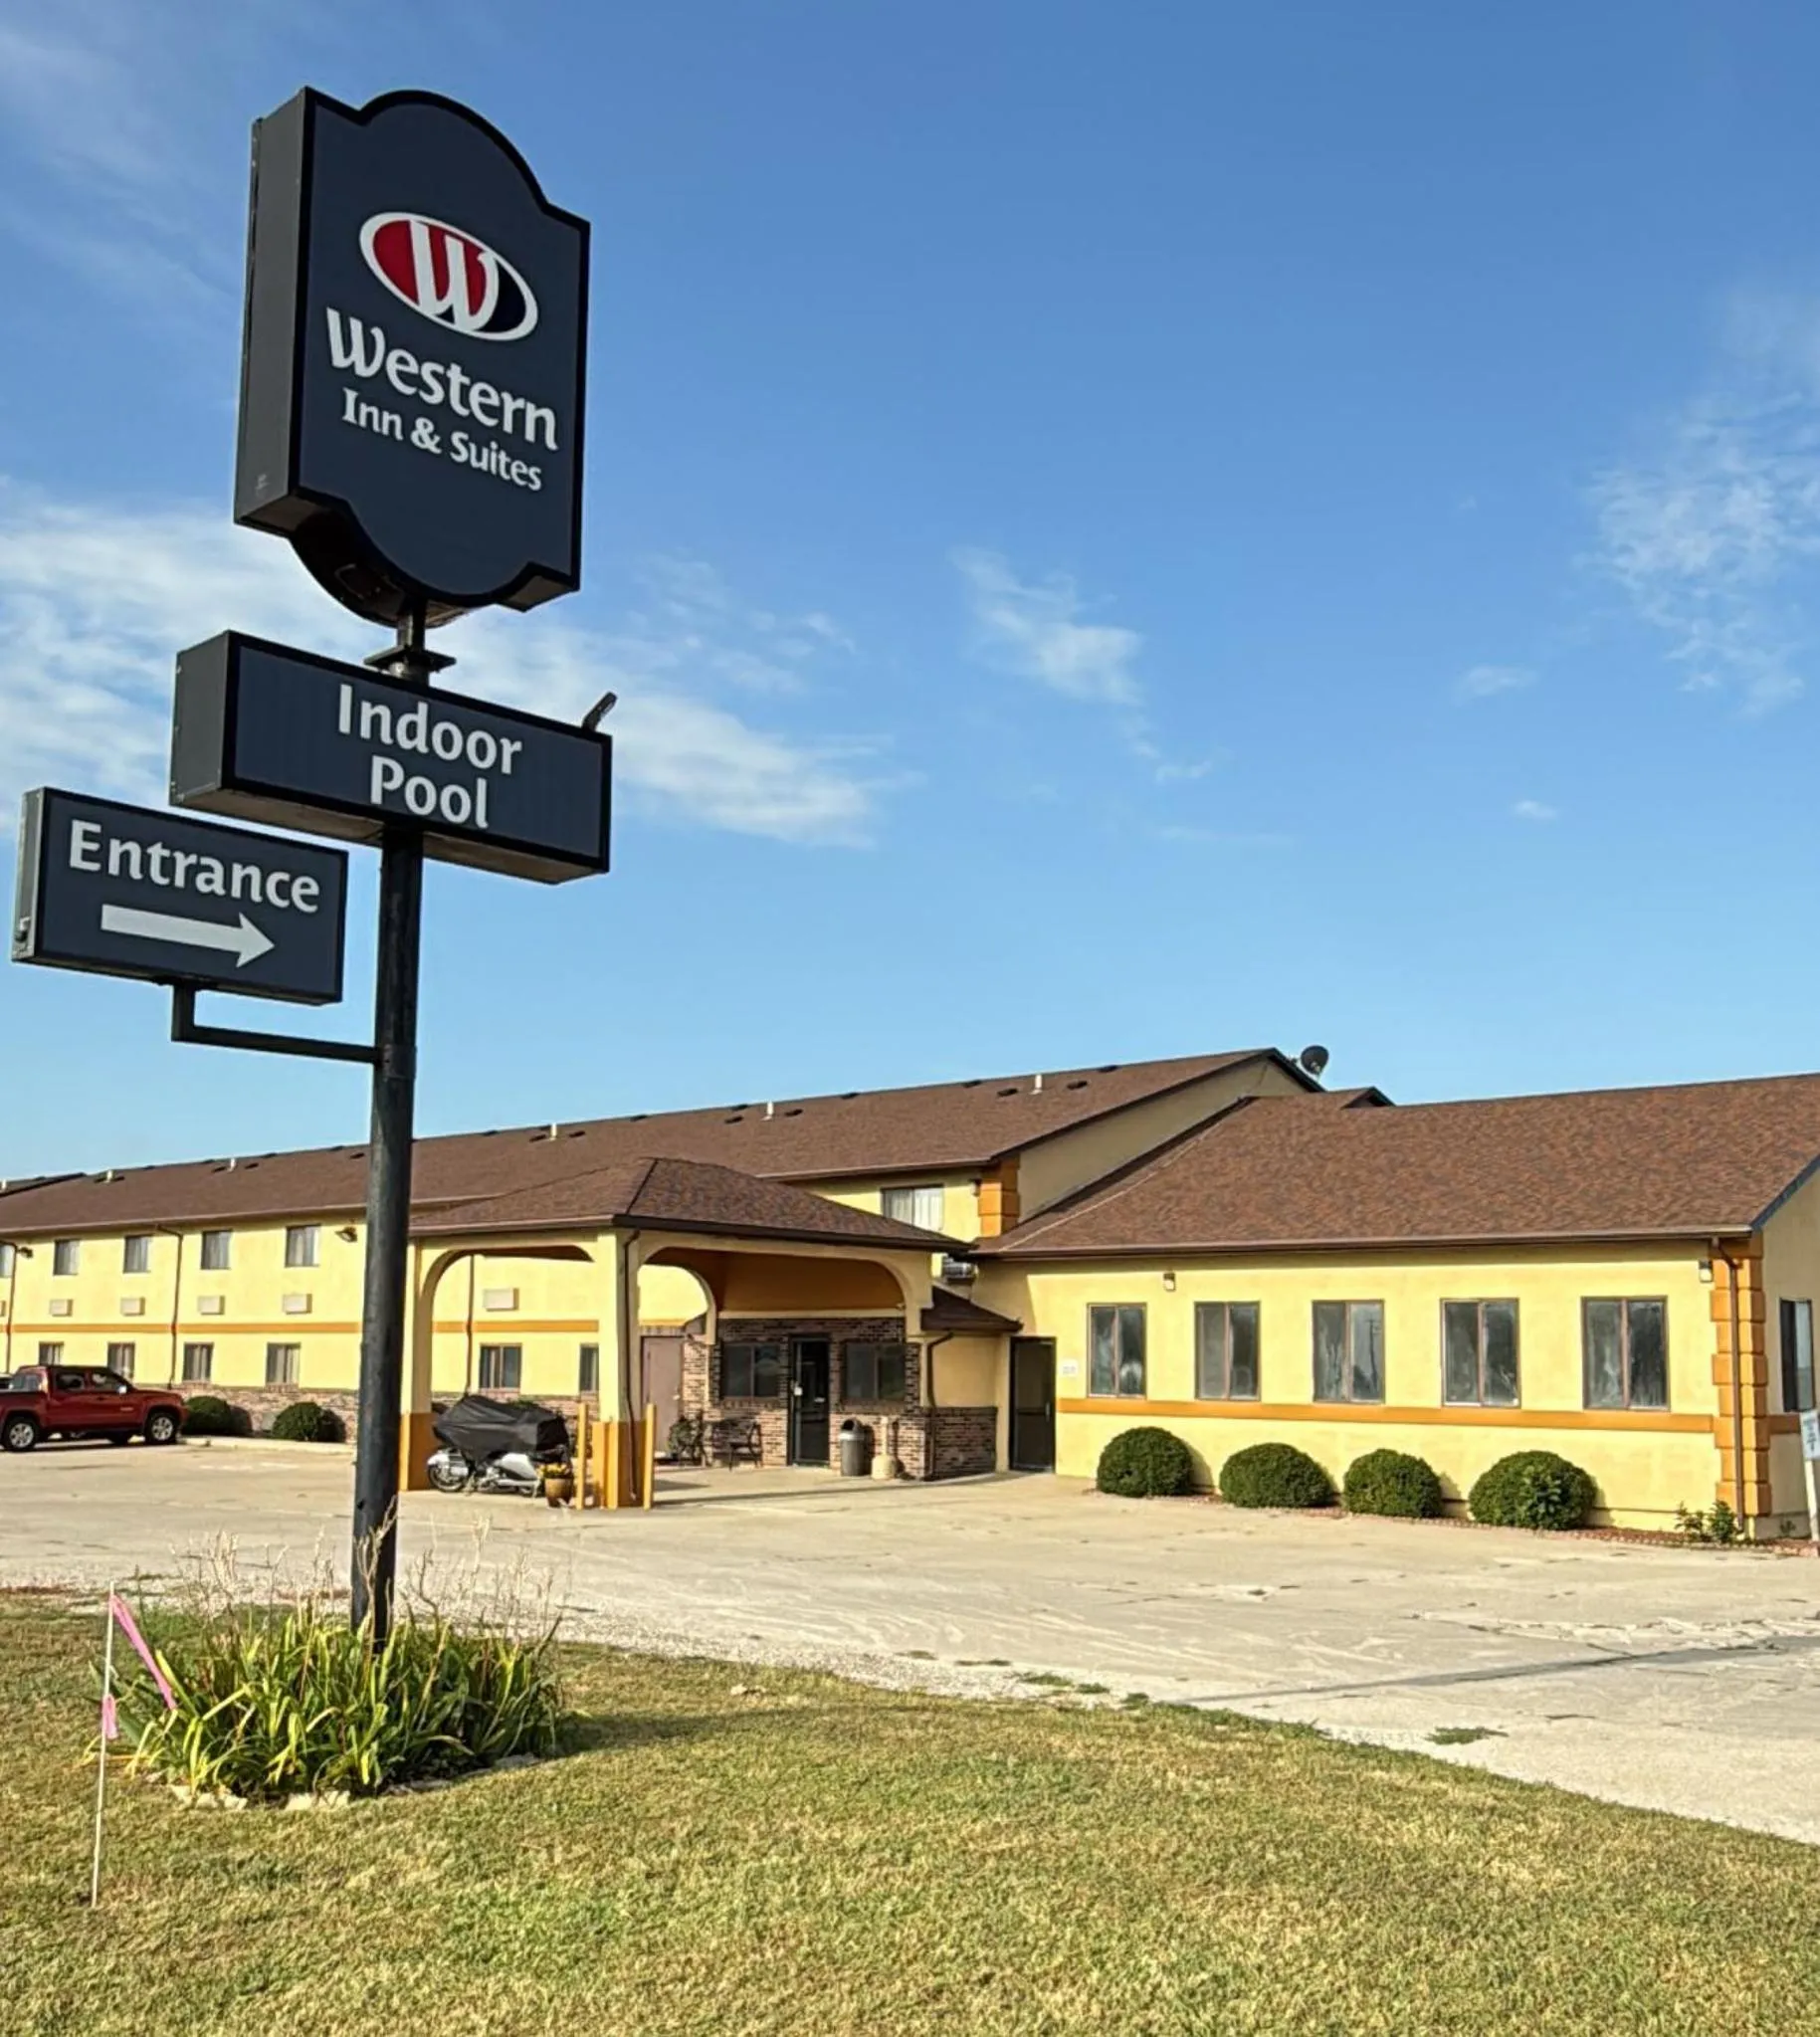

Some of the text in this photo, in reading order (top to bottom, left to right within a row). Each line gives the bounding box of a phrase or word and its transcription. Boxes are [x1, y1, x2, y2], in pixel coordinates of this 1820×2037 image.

[407, 219, 500, 332] W
[326, 307, 558, 451] Western
[342, 387, 542, 491] Inn & Suites
[338, 684, 522, 774] Indoor
[370, 755, 490, 829] Pool
[70, 819, 319, 913] Entrance
